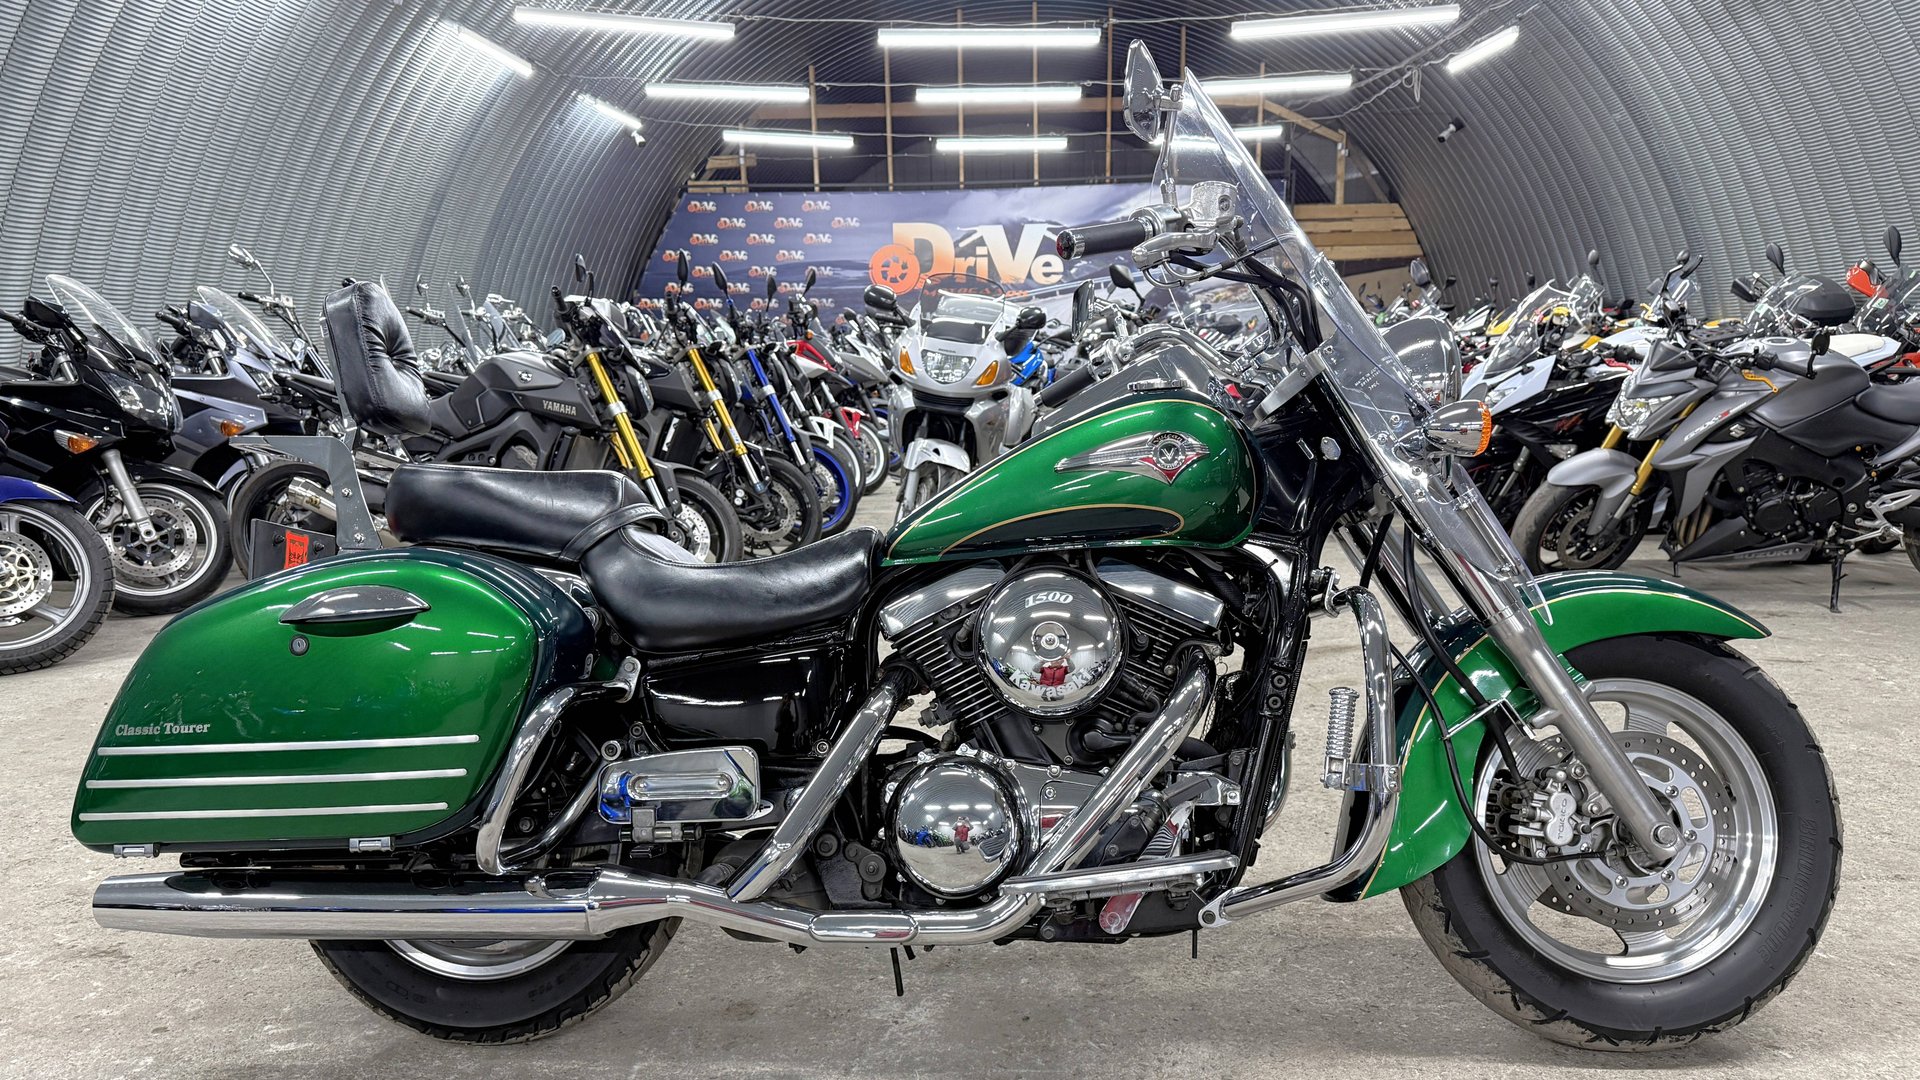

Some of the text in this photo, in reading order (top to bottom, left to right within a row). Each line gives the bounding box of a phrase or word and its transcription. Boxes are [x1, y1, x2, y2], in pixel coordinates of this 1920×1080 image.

[542, 399, 577, 416] YAMAHA
[1025, 591, 1073, 608] 1500
[1009, 669, 1094, 697] Kawasaki
[115, 722, 211, 736] Classic Tourer
